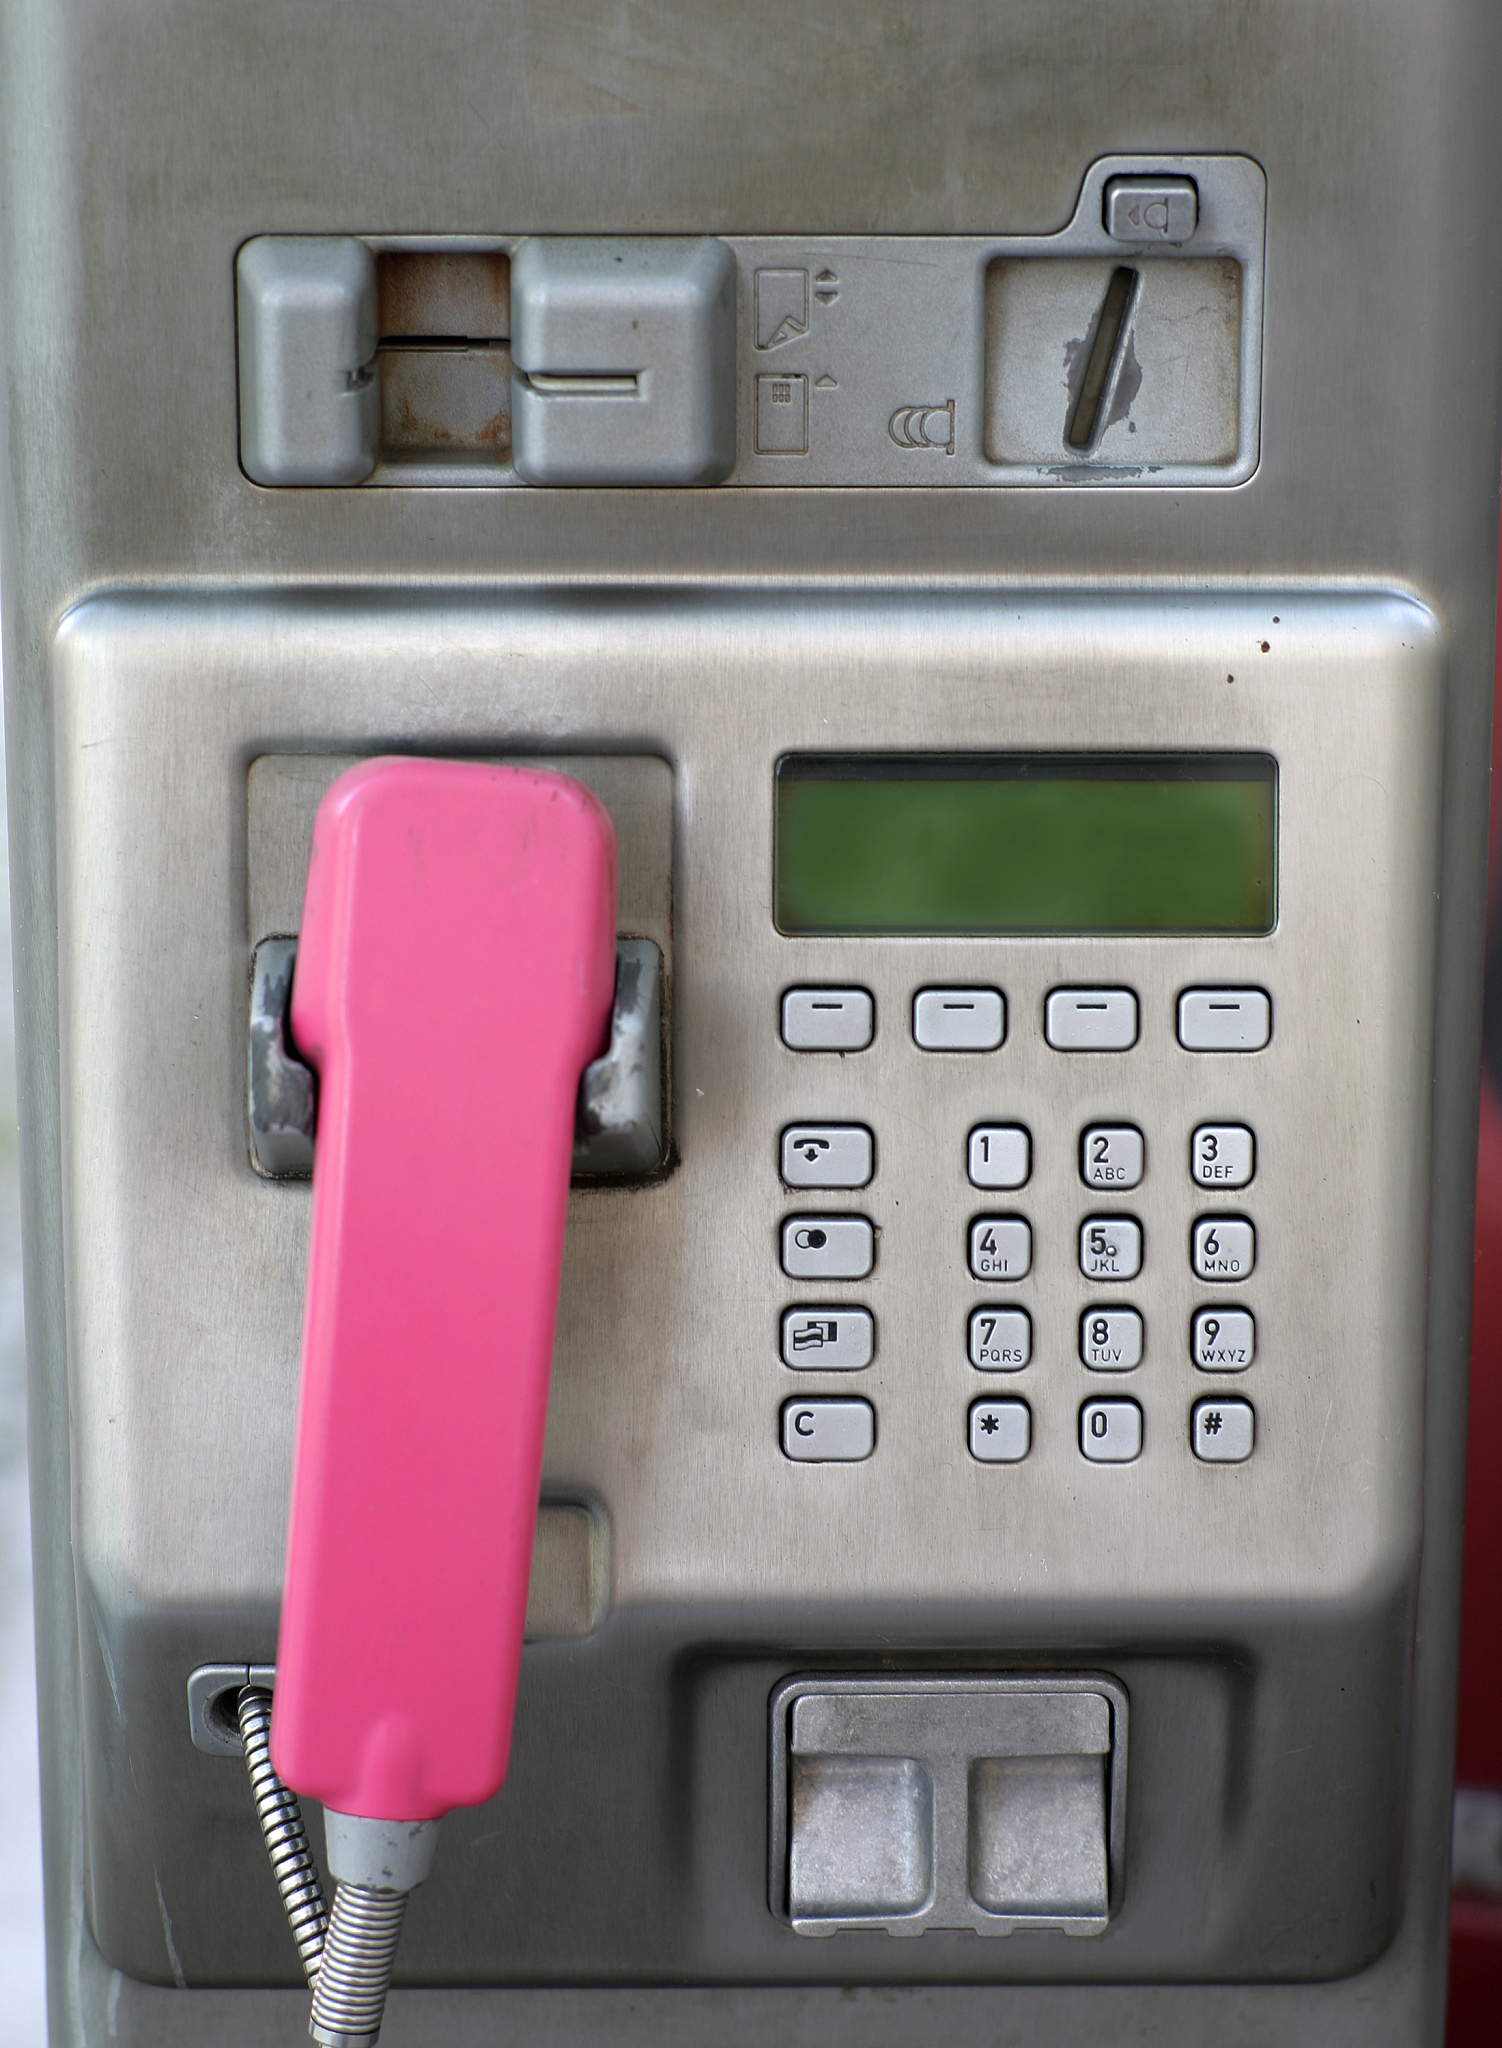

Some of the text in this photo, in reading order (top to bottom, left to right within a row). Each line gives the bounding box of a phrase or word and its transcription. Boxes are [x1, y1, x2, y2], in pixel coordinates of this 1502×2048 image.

[980, 1136, 989, 1162] 1
[1093, 1137, 1109, 1163] 2
[1201, 1135, 1218, 1161] 3
[1092, 1168, 1125, 1181] ABC
[1203, 1166, 1233, 1178] DEF
[980, 1228, 997, 1255] 4
[1090, 1229, 1107, 1255] 5
[1204, 1229, 1219, 1255] 6
[981, 1259, 1007, 1271] GHI
[1090, 1259, 1120, 1272] JKL
[1205, 1260, 1239, 1271] MNO
[981, 1319, 996, 1345] 7
[1092, 1319, 1108, 1345] 8
[1205, 1319, 1220, 1345] 9
[980, 1349, 1023, 1363] PQRS
[1092, 1349, 1121, 1361] TUV
[1202, 1349, 1246, 1362] WXYZ
[795, 1411, 814, 1436] C
[1092, 1411, 1107, 1438] 0
